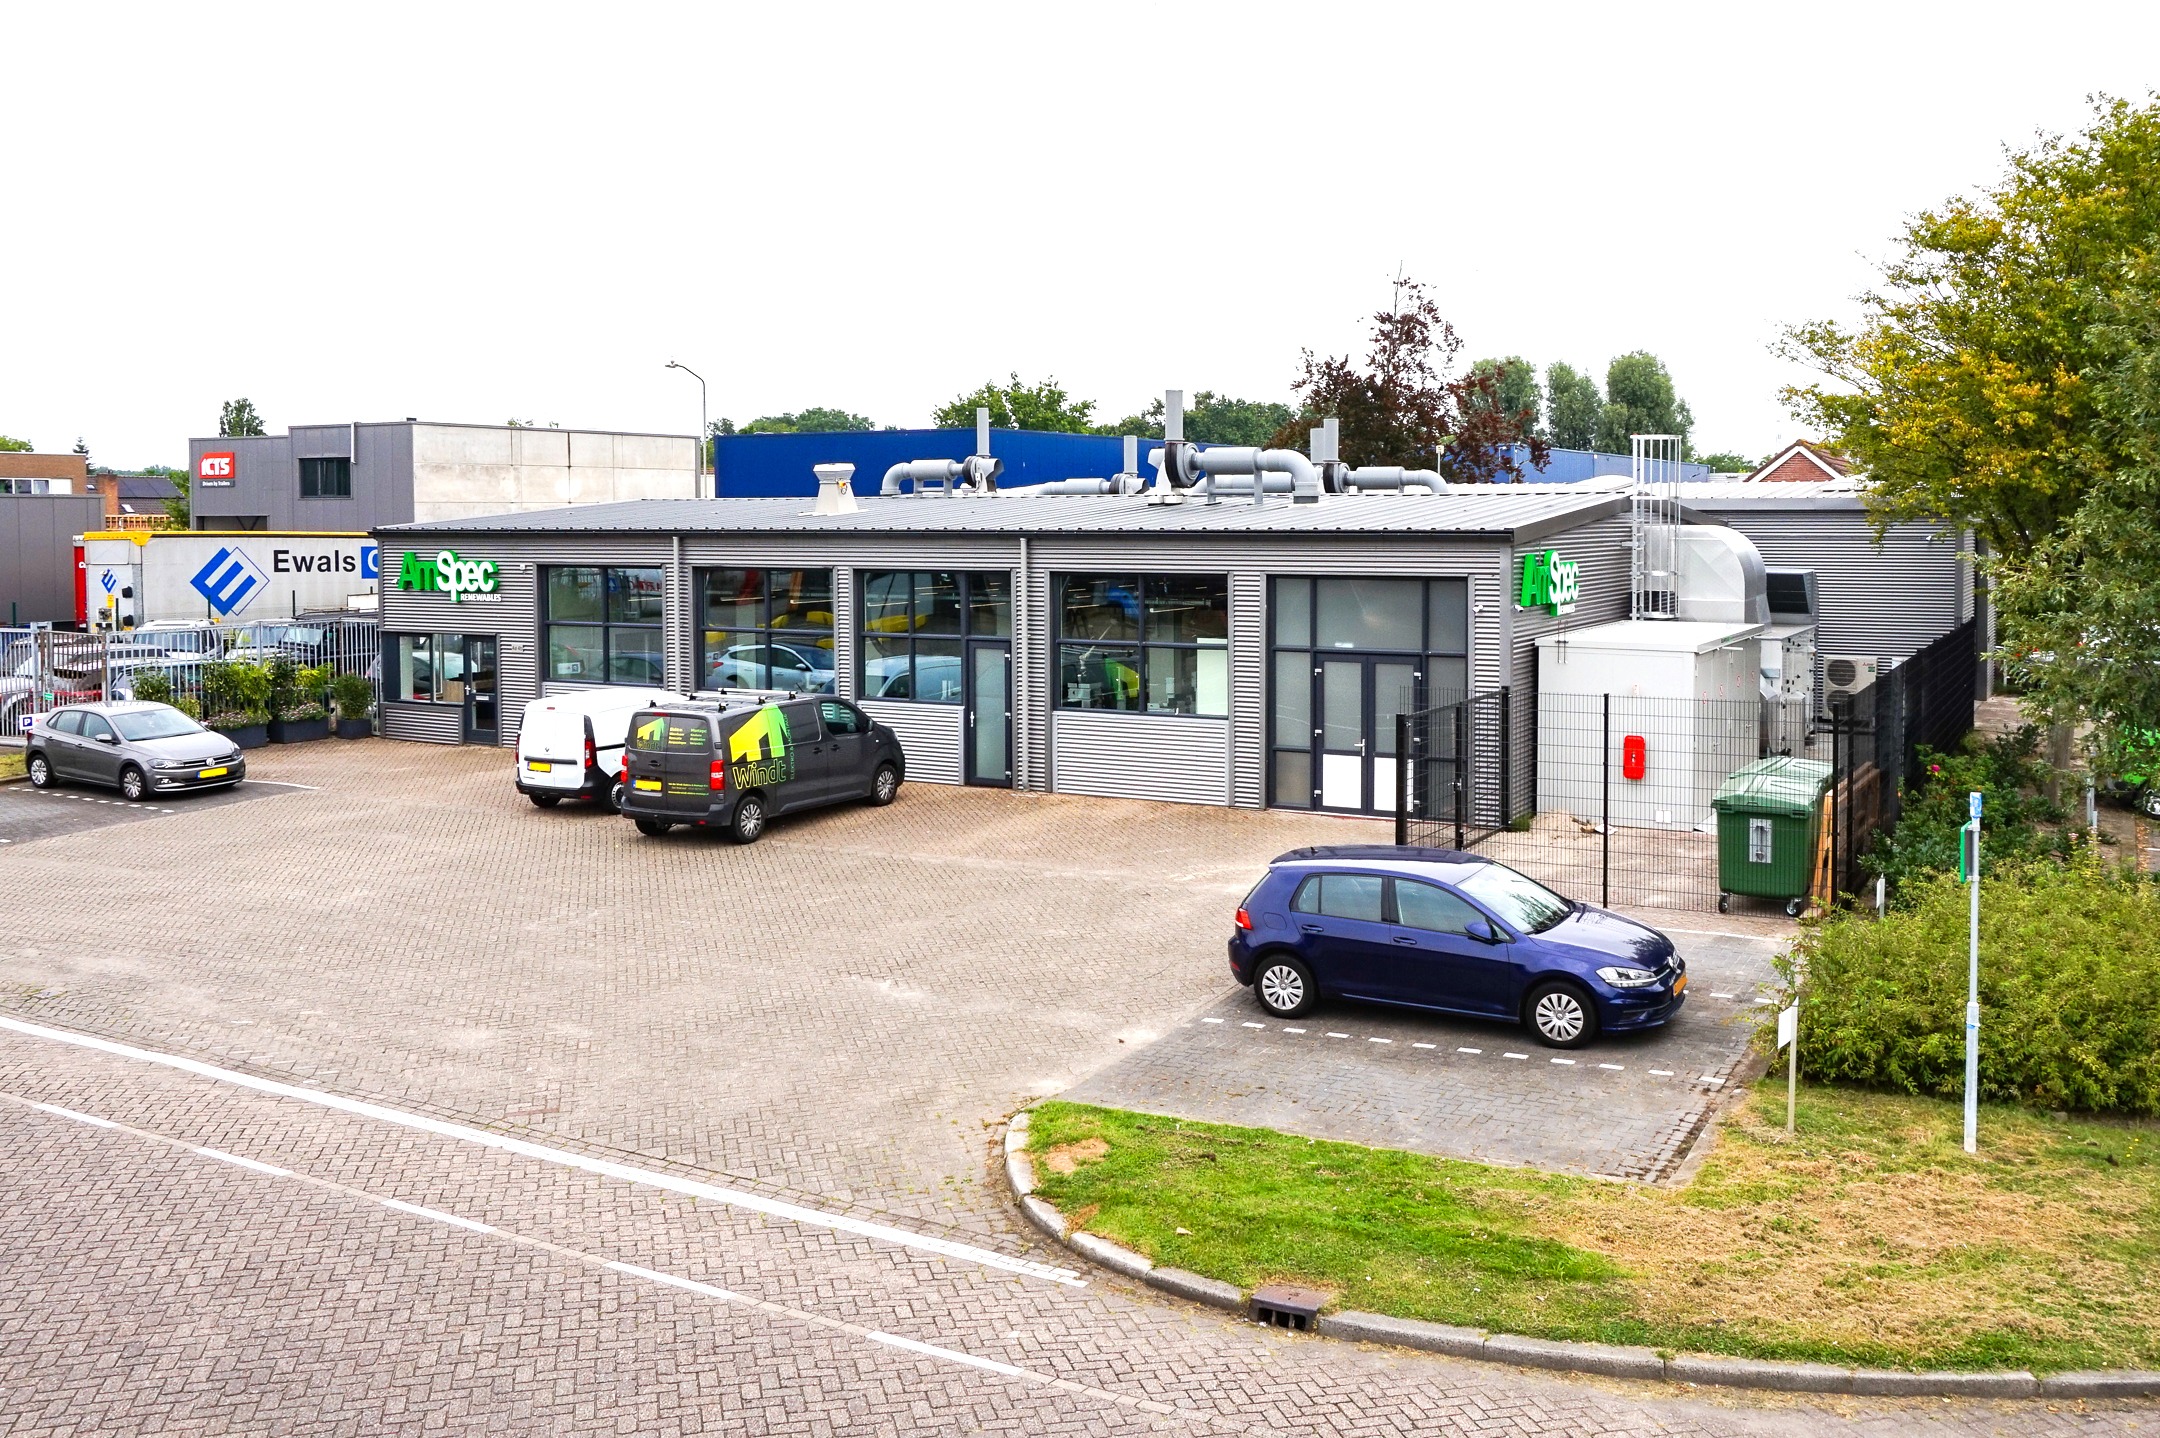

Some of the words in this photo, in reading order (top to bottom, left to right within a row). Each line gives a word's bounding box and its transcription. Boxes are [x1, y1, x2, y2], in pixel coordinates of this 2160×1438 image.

[273, 549, 357, 573] Ewals
[397, 550, 499, 602] AmSpec
[460, 592, 502, 603] RENEWABLES
[1520, 549, 1579, 617] AmSpec
[732, 758, 787, 790] Windt
